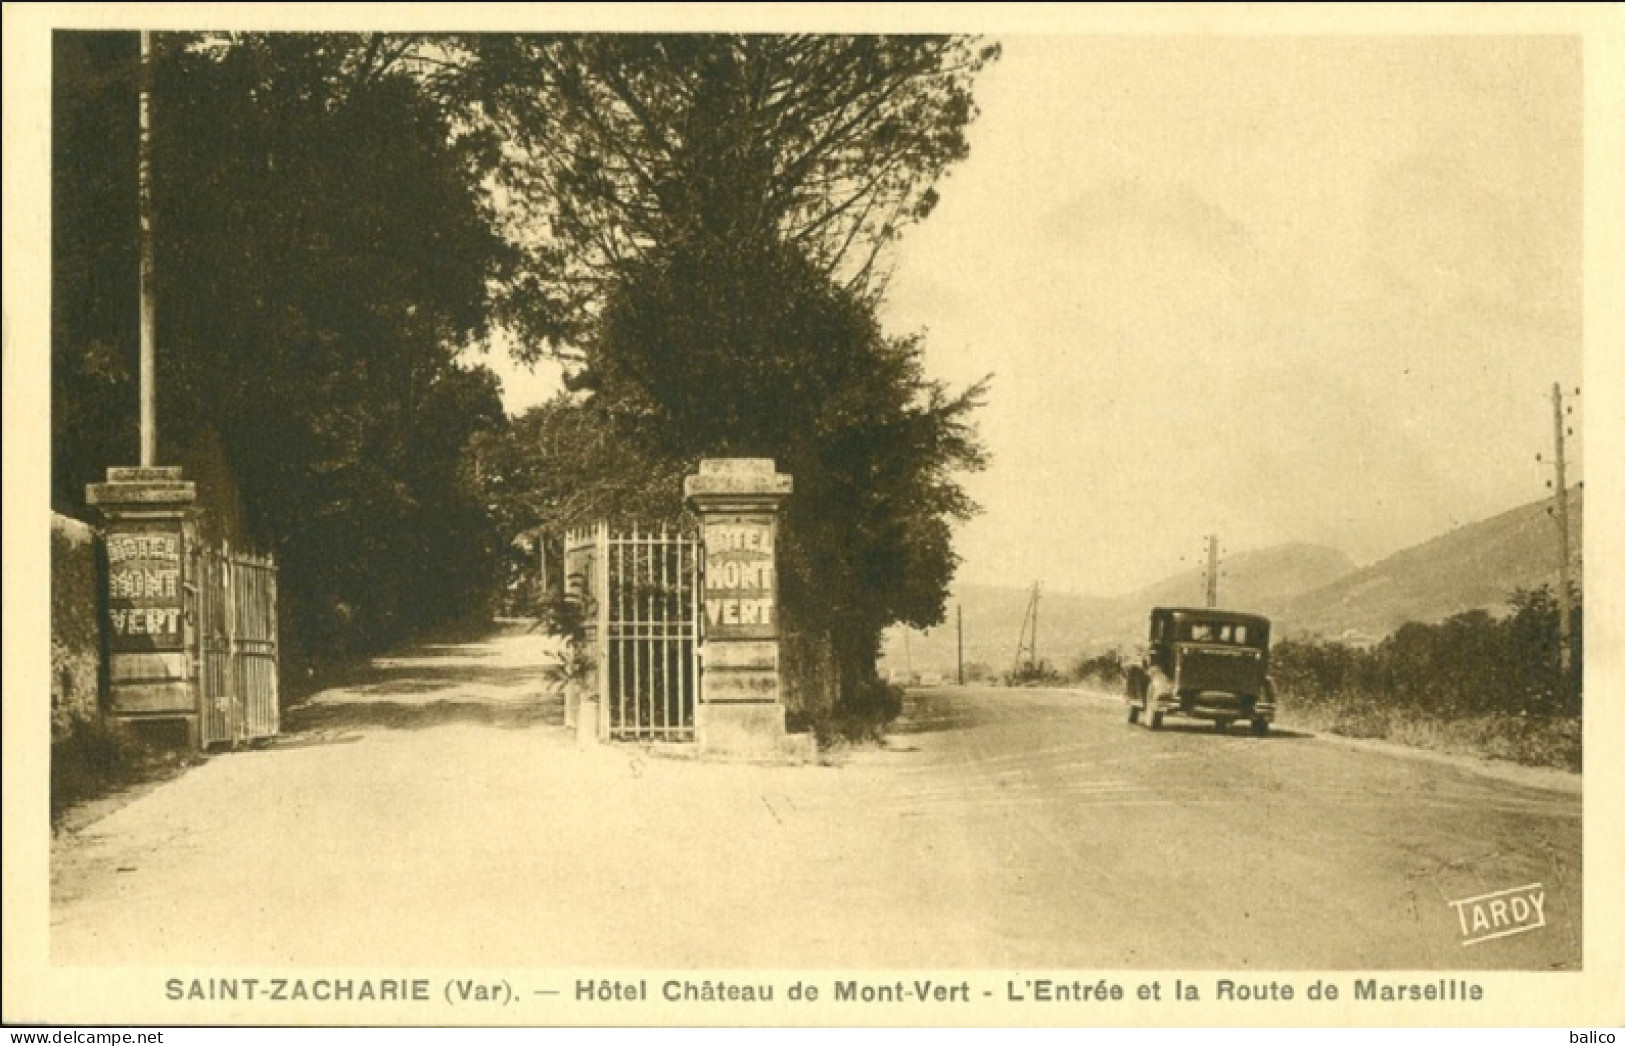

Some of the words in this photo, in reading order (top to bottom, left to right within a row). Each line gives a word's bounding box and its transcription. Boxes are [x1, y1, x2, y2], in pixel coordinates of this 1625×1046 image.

[109, 570, 179, 598] MONT
[706, 561, 773, 590] MONT
[109, 609, 181, 634] VERT
[706, 599, 773, 626] VERT
